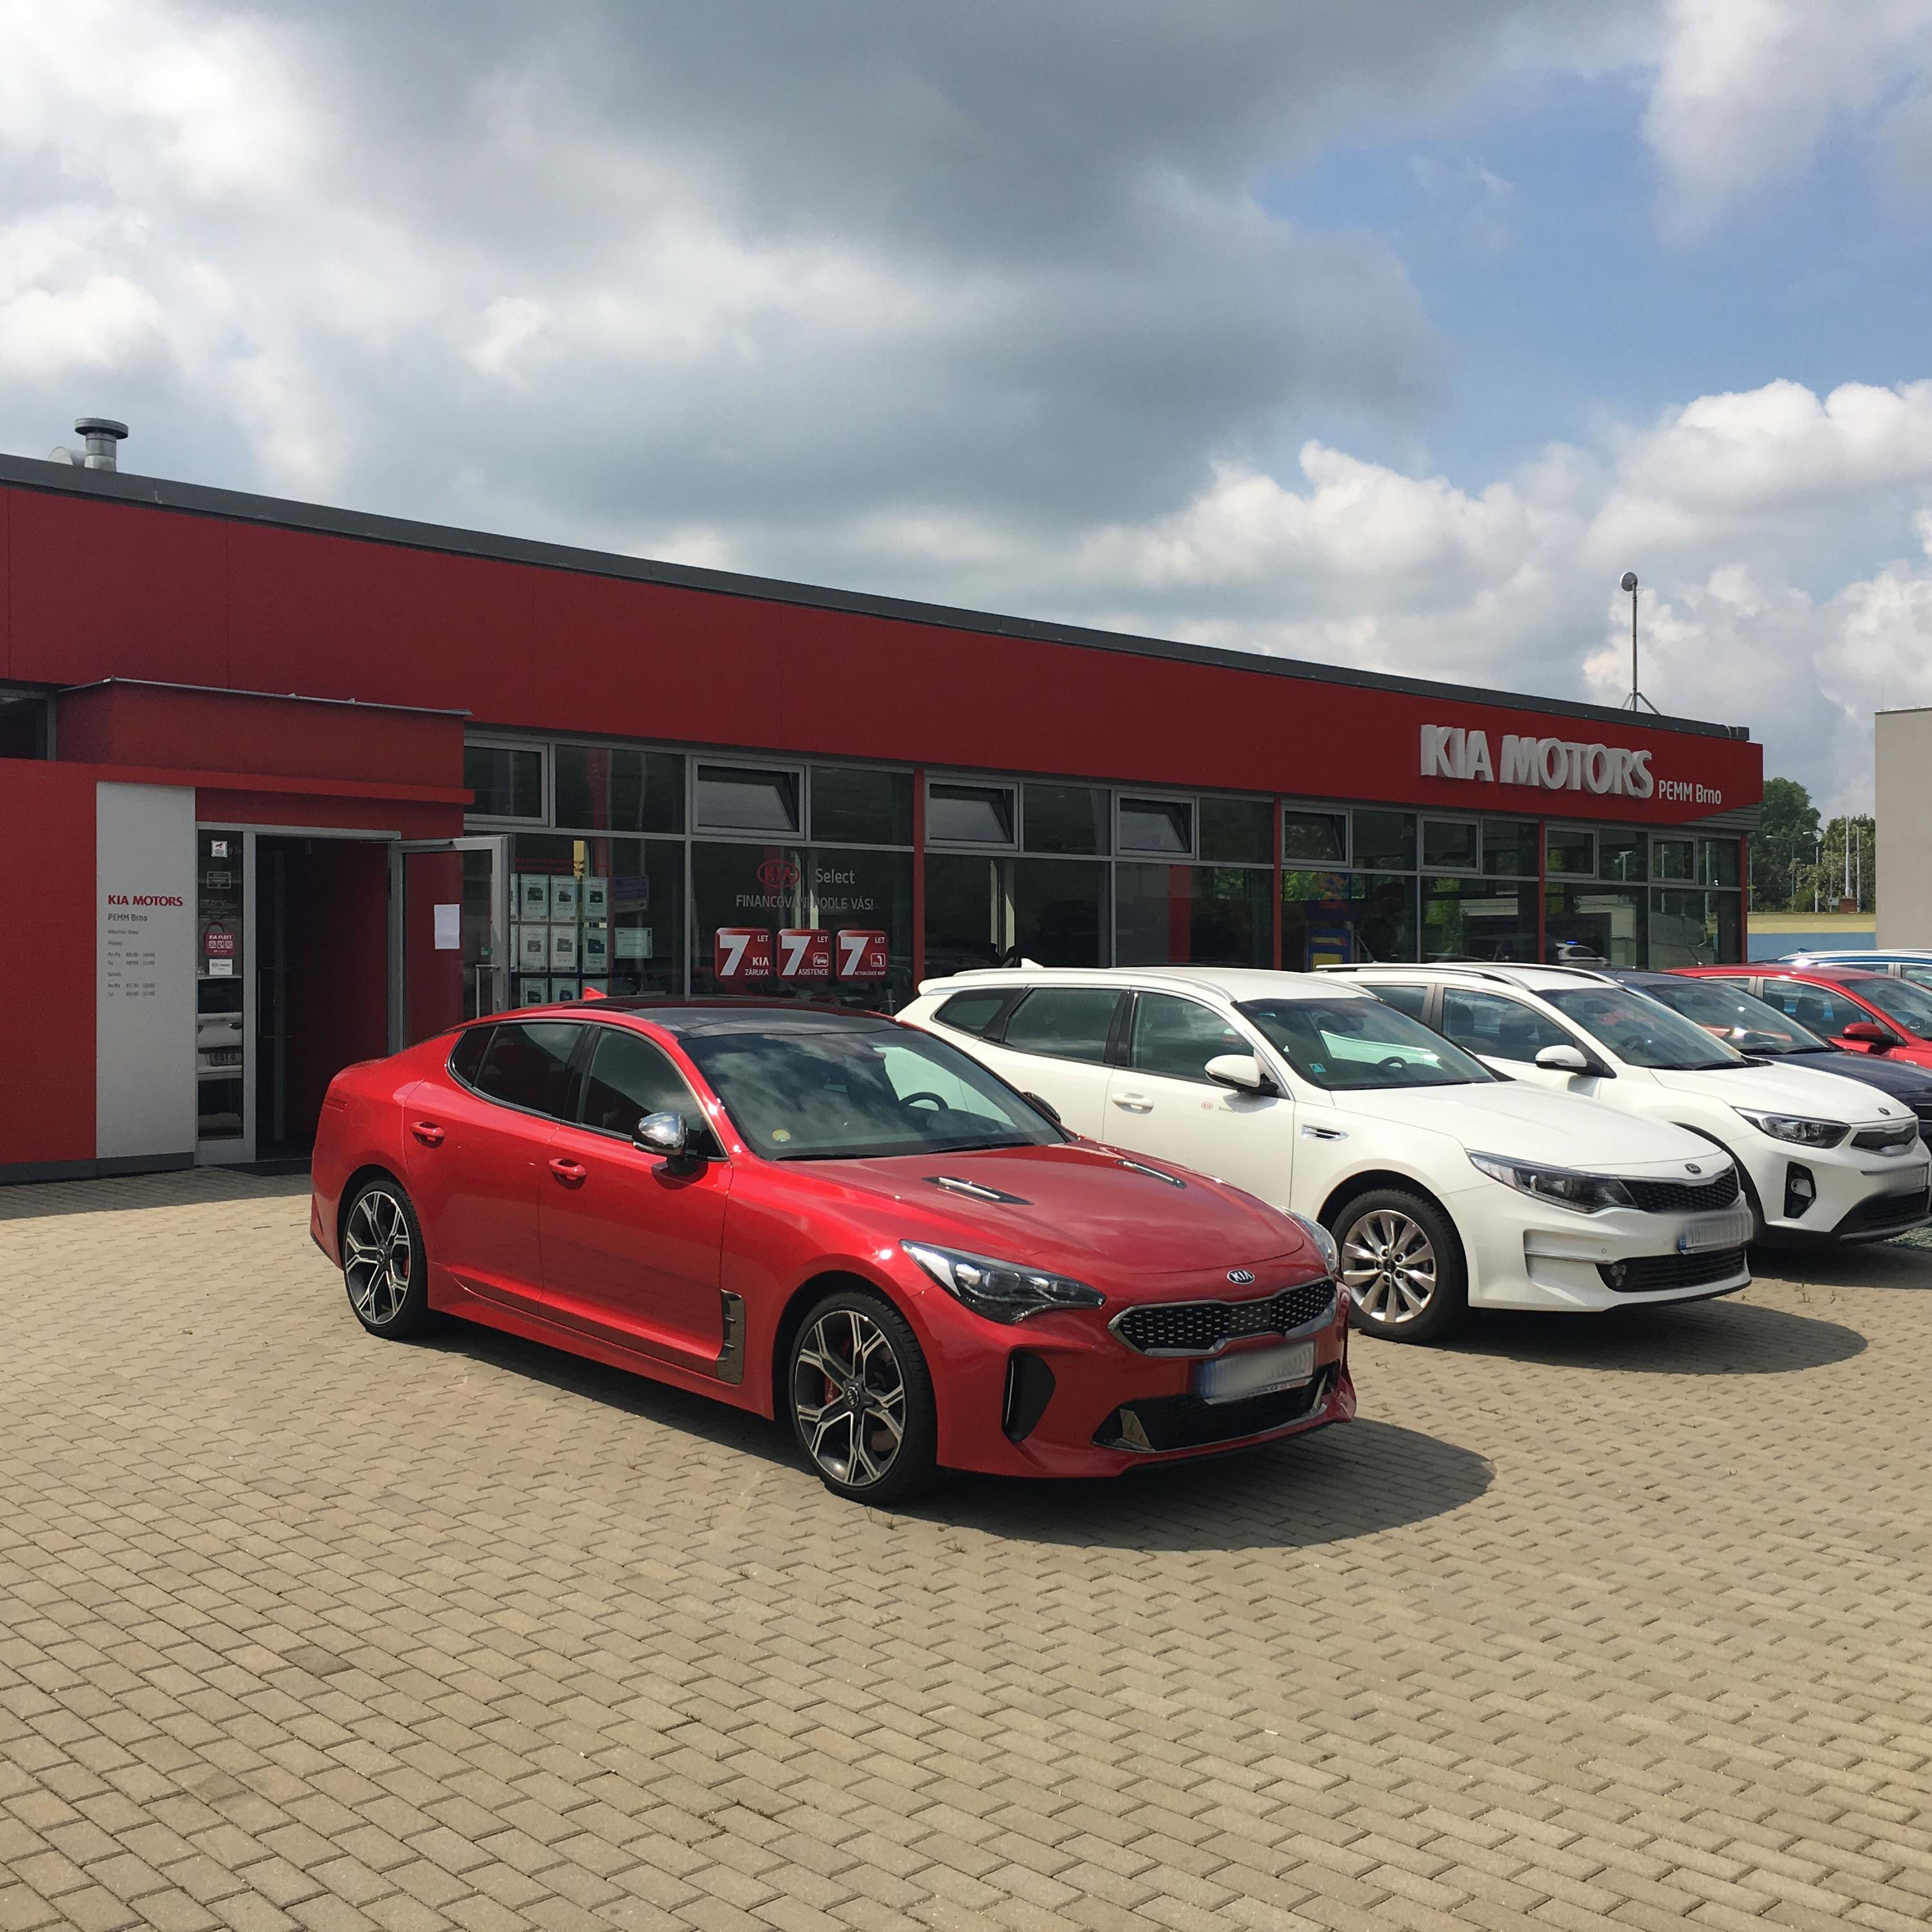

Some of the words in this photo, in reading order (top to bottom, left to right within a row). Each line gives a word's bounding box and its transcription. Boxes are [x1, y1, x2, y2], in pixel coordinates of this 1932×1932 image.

[1421, 724, 1494, 782] KIA
[1499, 734, 1654, 799] MOTORS
[1658, 779, 1692, 802] PEMM
[1695, 784, 1722, 805] Brno
[815, 868, 855, 884] Select
[108, 895, 129, 905] KIA
[133, 895, 184, 907] MOTORS
[108, 913, 129, 922] PEMM
[719, 934, 751, 976] 7
[757, 934, 770, 943] LET
[752, 956, 770, 967] KIA
[781, 935, 812, 976] 7
[840, 936, 870, 976] 7
[744, 967, 770, 976] ZÁRUKA
[798, 968, 829, 976] ASISTENCE
[1229, 1270, 1253, 1282] KIA
